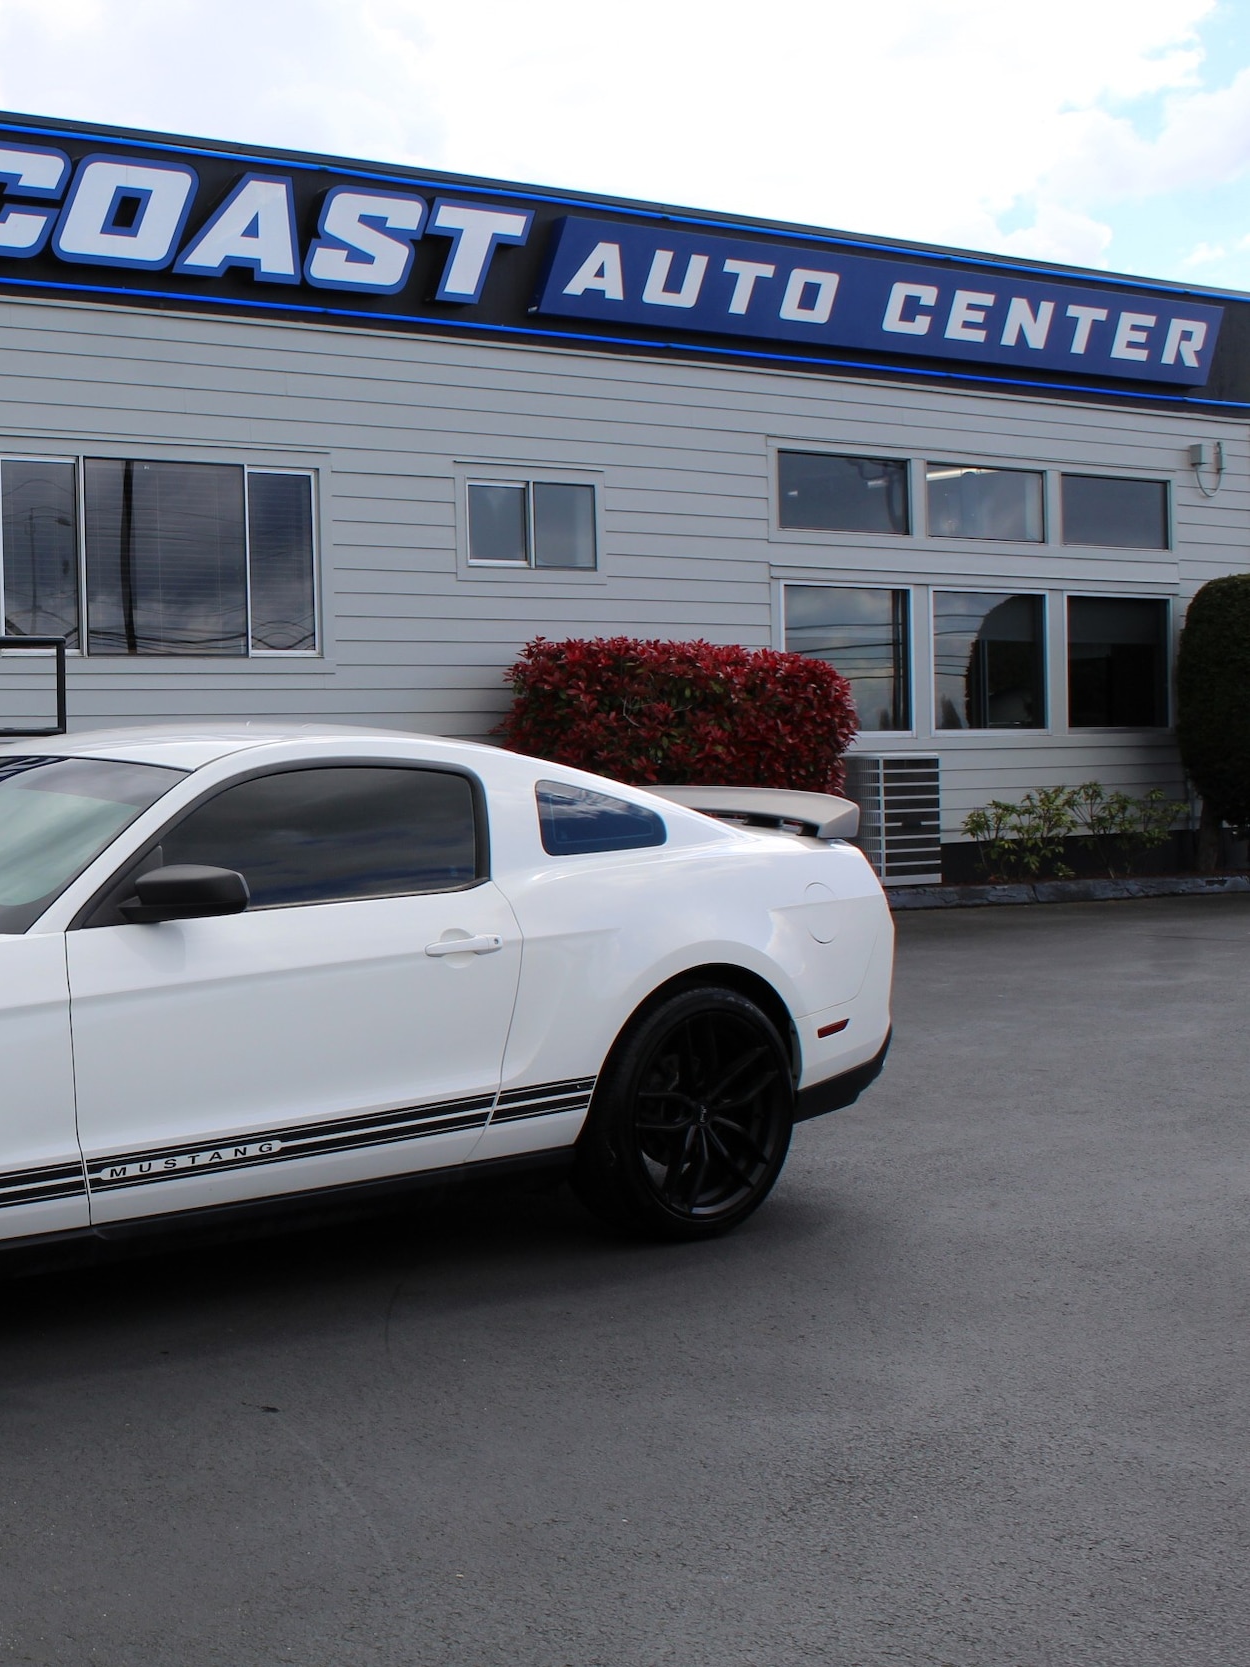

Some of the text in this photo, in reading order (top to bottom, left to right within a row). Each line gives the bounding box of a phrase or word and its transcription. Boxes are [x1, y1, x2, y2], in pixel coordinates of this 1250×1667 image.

[562, 241, 1207, 368] AUTO CENTER
[109, 1142, 273, 1179] MUSTANG
